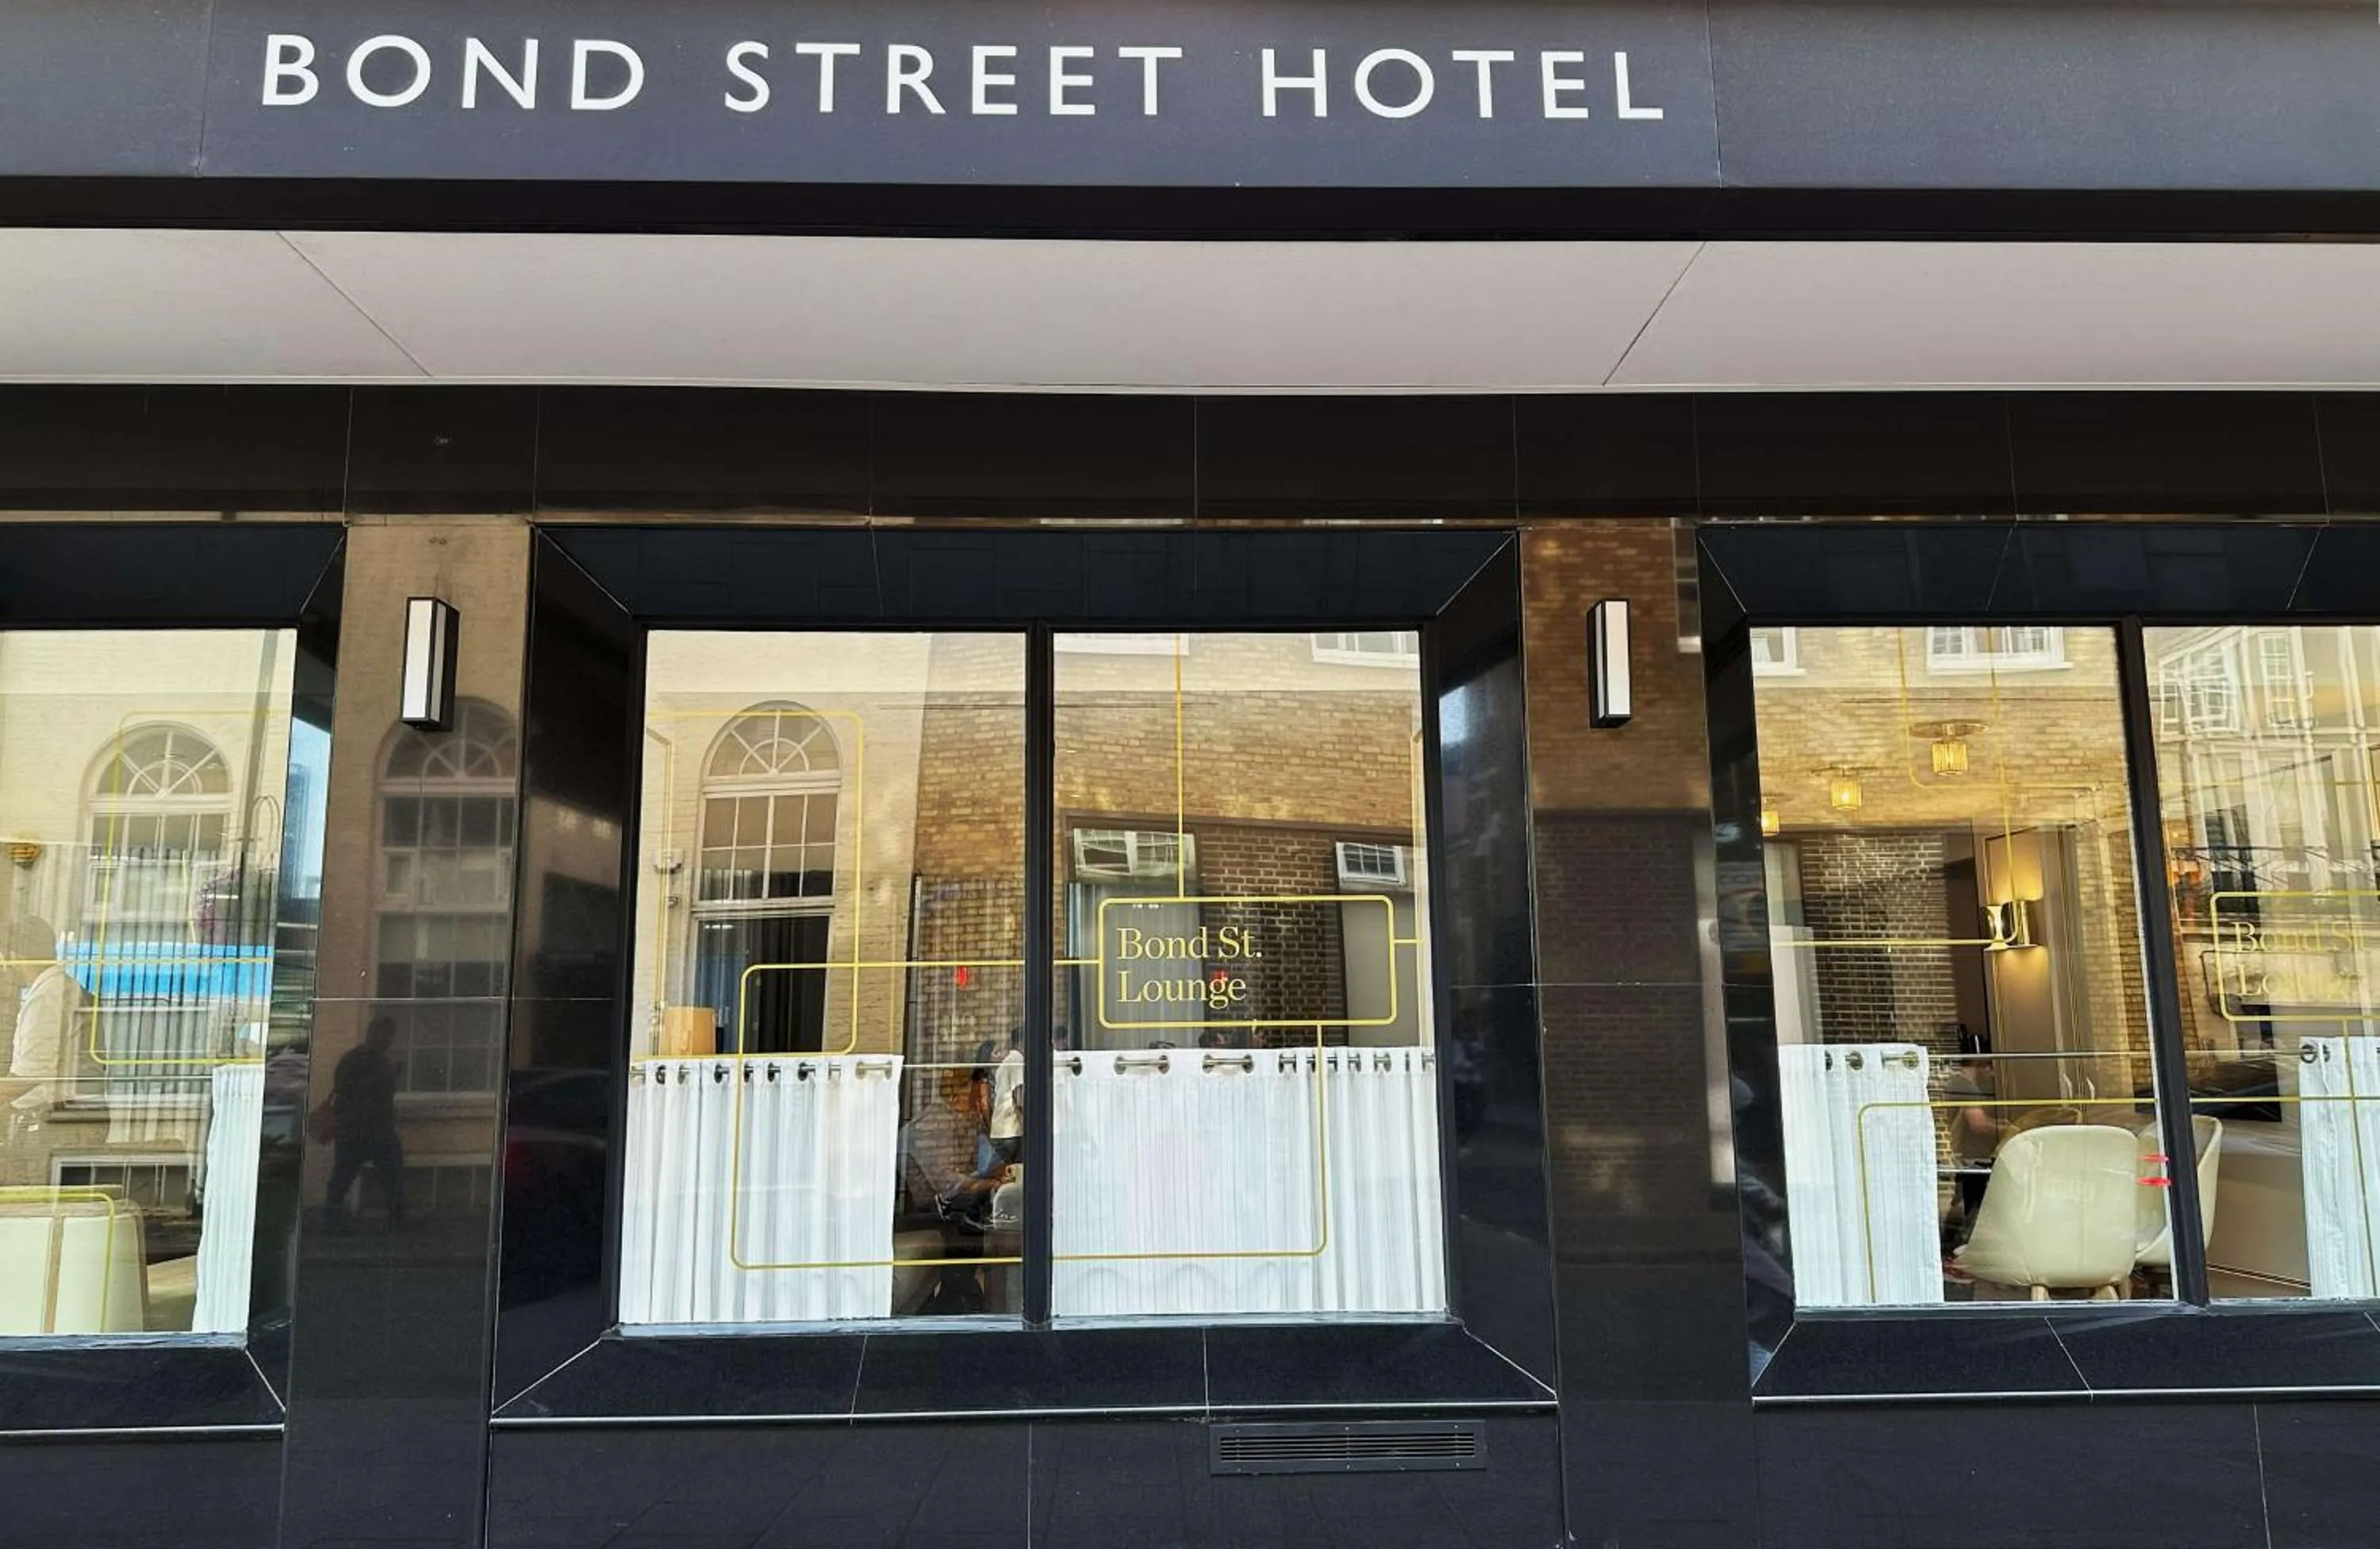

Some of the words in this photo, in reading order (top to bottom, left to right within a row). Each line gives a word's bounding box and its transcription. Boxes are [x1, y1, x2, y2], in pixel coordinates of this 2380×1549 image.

[262, 34, 645, 111] BOND
[724, 40, 1183, 116] STREET
[1261, 48, 1664, 120] HOTEL
[1116, 927, 1209, 959] Bond
[1218, 926, 1262, 959] St.
[1116, 971, 1247, 1009] Lounge
